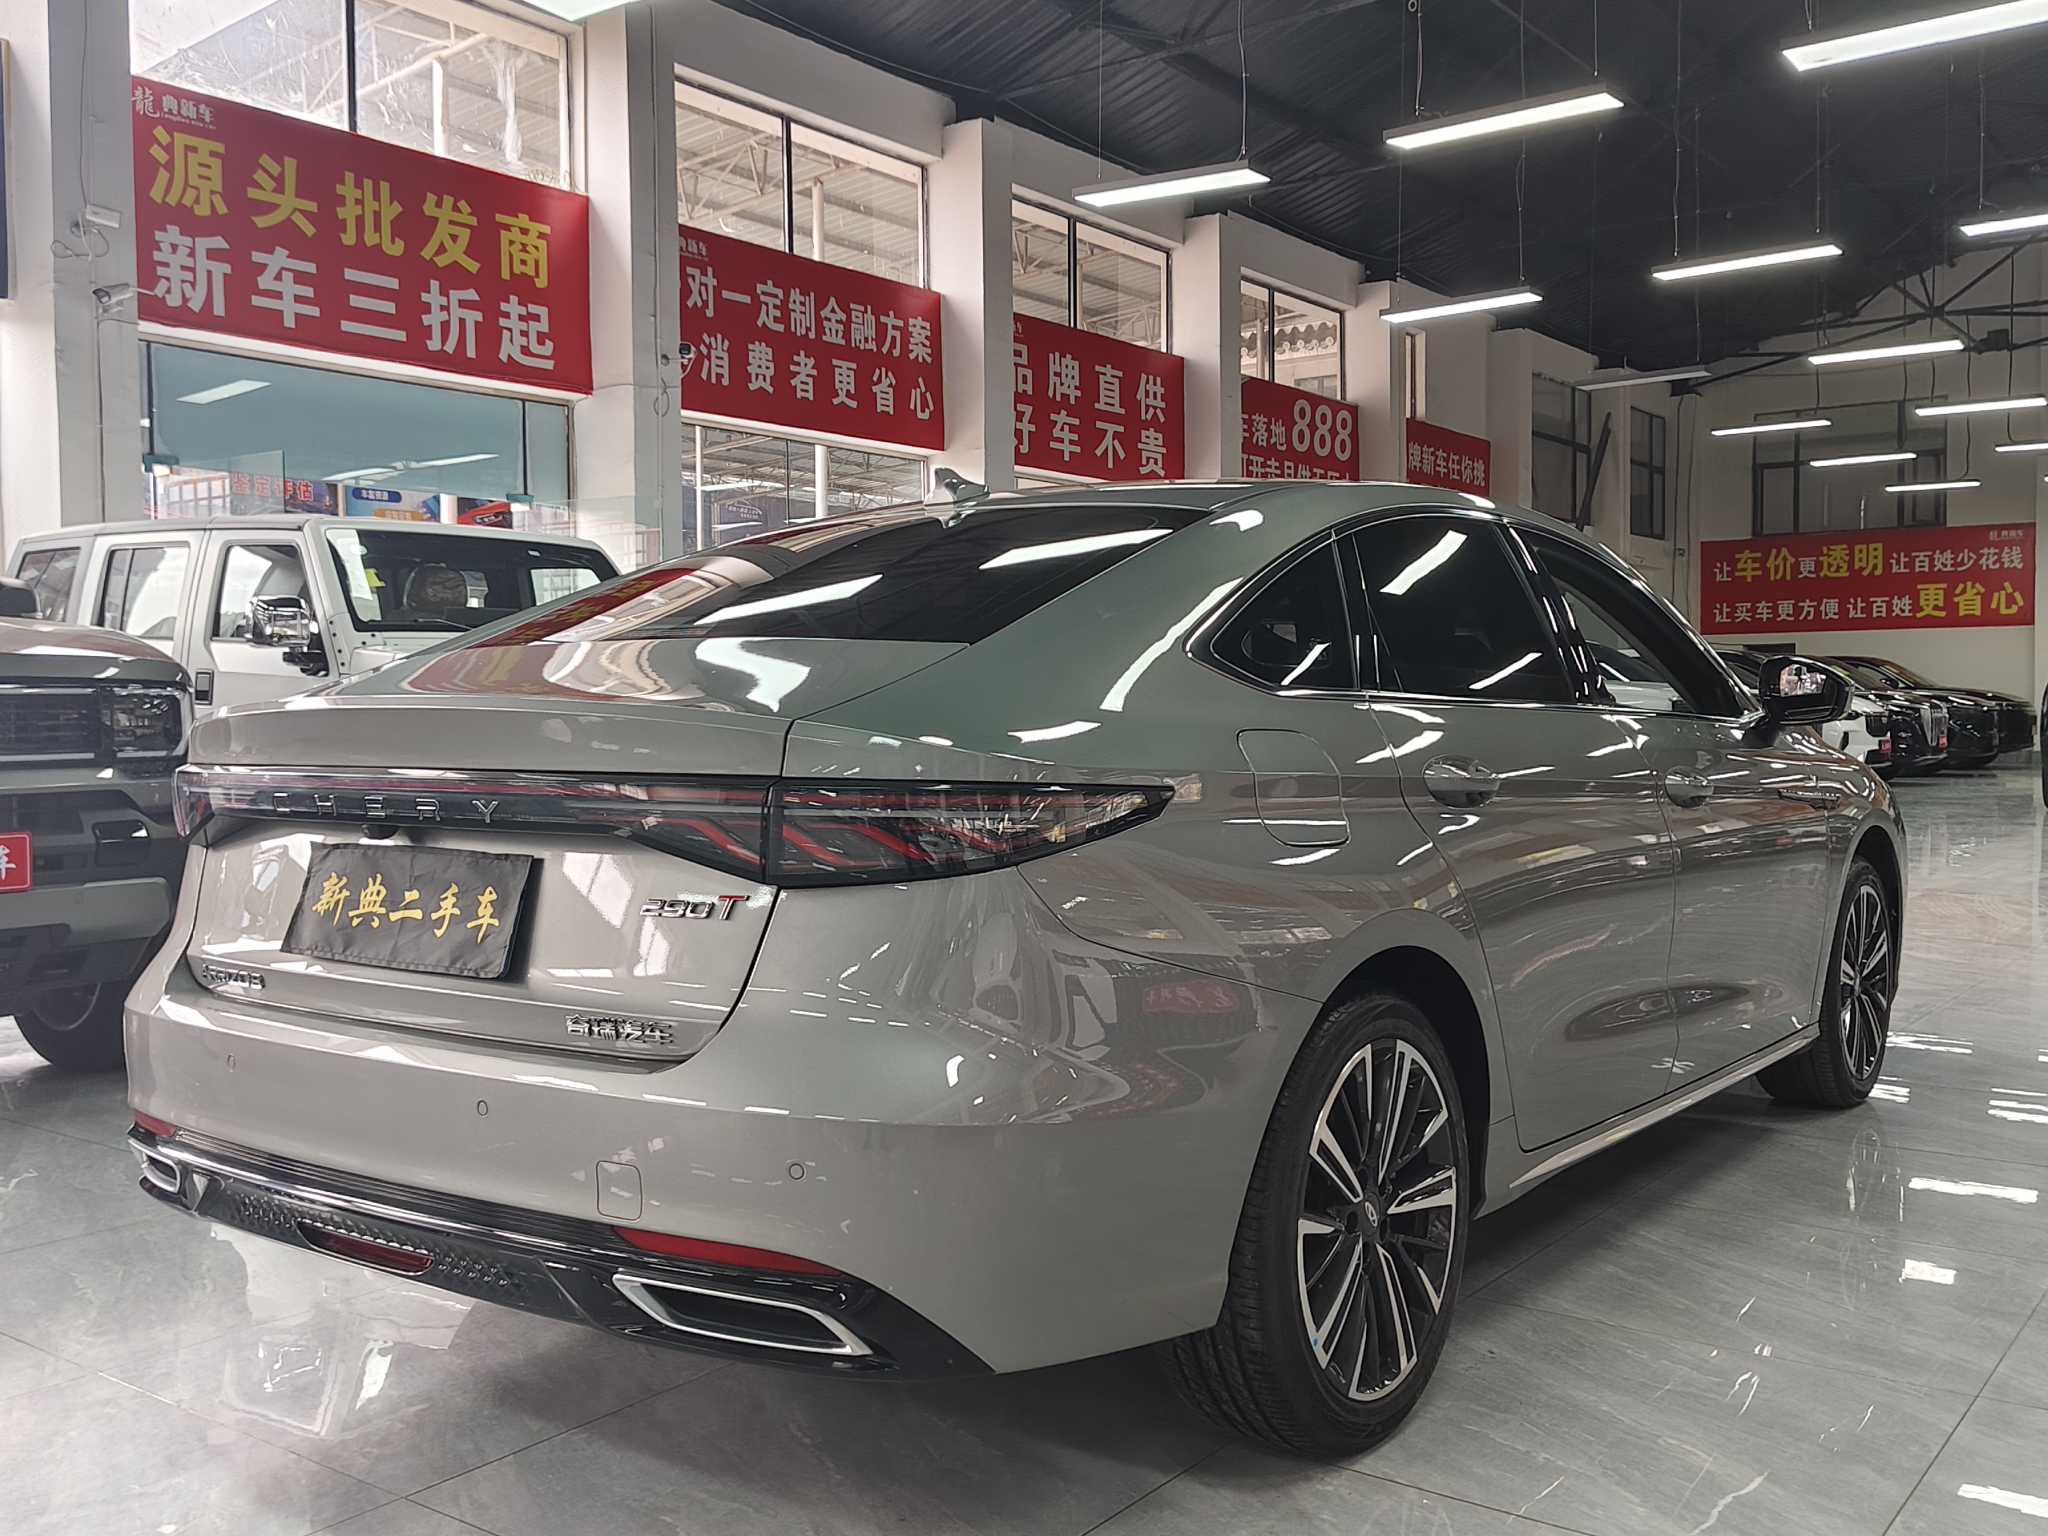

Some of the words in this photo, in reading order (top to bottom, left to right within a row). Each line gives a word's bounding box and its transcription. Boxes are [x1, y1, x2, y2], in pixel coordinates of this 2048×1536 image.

[149, 126, 552, 288] 源头批发商
[152, 224, 555, 370] 新车三折起
[686, 266, 932, 363] 对一定制金融方案
[700, 333, 934, 420] 消费者更省心
[1013, 342, 1166, 423] 品牌直供
[1014, 403, 1167, 477] 好车不贵
[1713, 542, 1884, 582] 让车价更透明
[1890, 545, 2024, 574] 让百姓少花钱
[1713, 599, 1840, 624] 让买车更方便
[1847, 581, 2025, 619] 让百姓更省心
[273, 792, 499, 824] CHERY
[311, 871, 501, 944] 新典二手车
[640, 895, 751, 921] 290T
[565, 1014, 675, 1045] 奇瑞汽车
